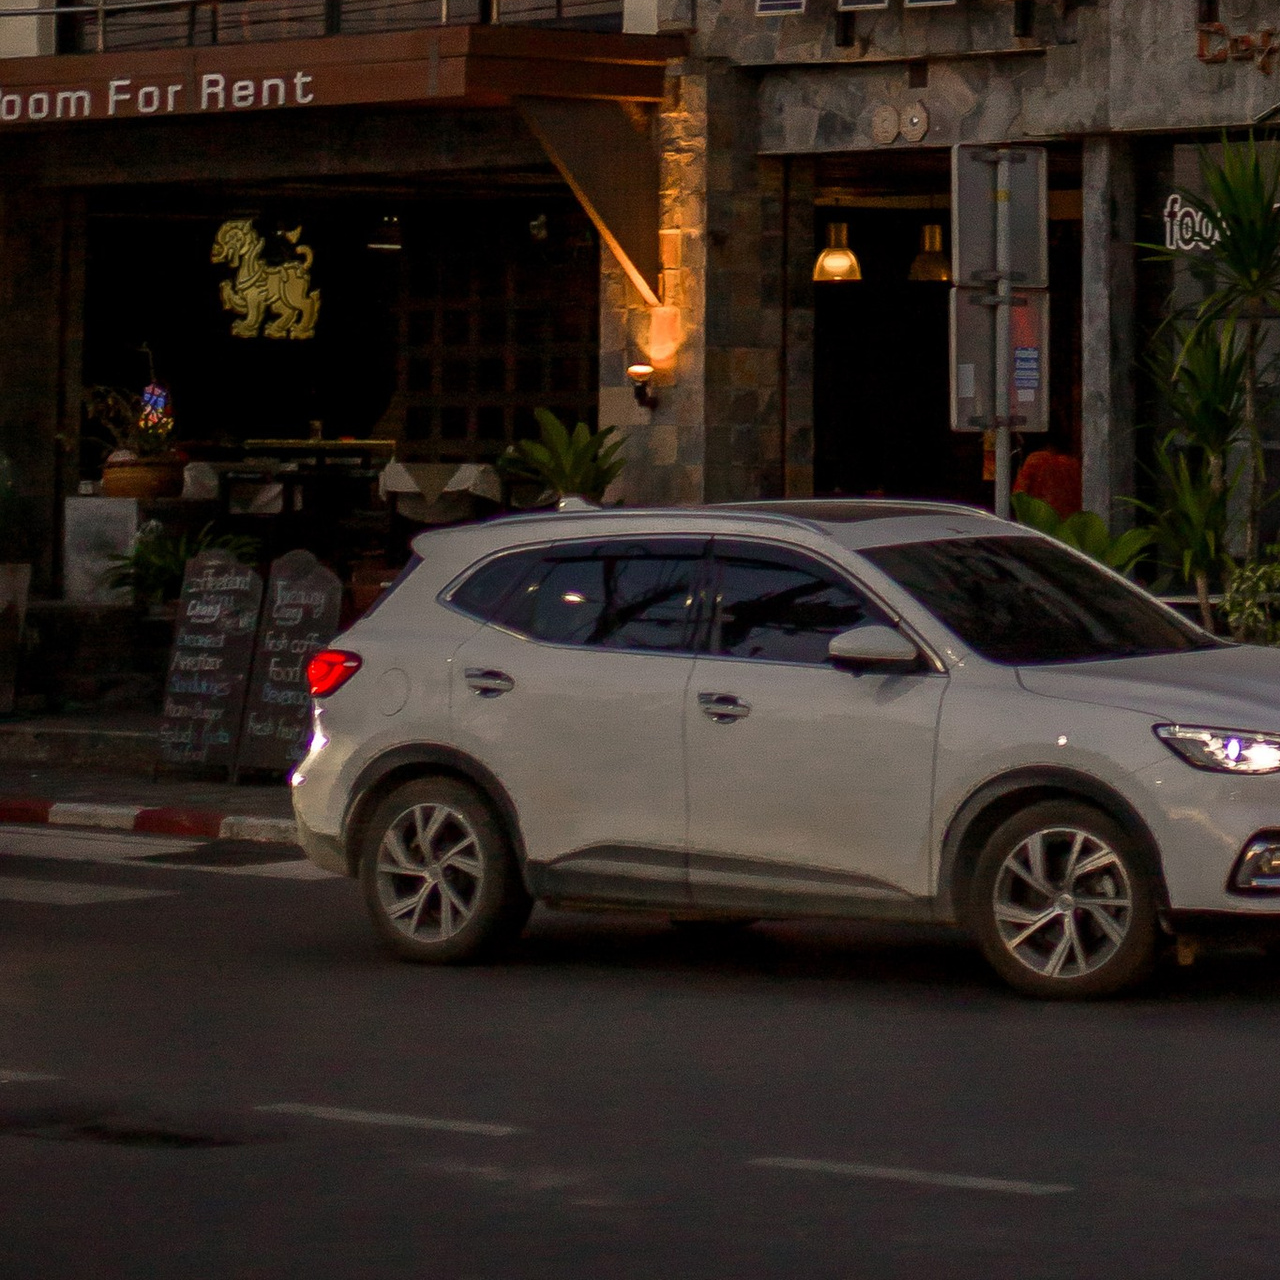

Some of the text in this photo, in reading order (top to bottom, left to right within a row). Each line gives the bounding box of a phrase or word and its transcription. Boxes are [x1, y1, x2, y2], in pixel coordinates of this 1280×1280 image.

[0, 70, 315, 122] oom For Rent
